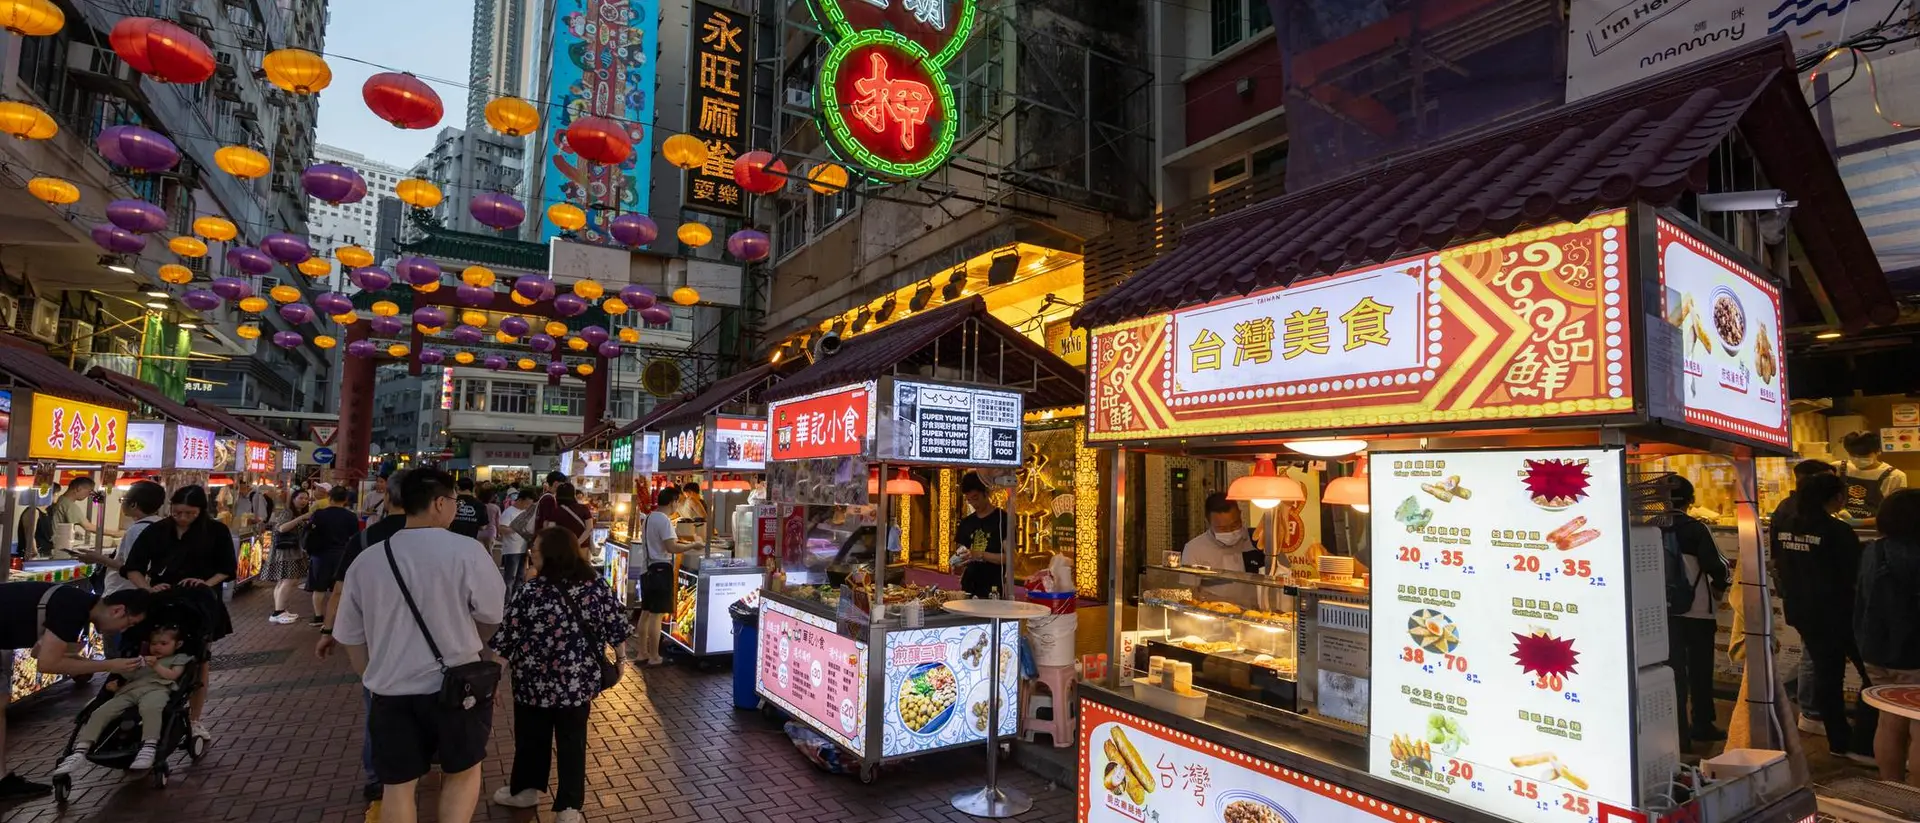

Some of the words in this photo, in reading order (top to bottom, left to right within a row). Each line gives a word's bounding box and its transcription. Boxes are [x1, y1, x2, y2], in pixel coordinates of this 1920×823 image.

[1601, 16, 1631, 40] I'm
[699, 11, 742, 181] 永旺麻雀
[851, 52, 934, 151] 押
[1256, 294, 1281, 305] TAIWAN
[1188, 295, 1394, 374] 台灣美食
[921, 412, 944, 422] SUPER
[944, 414, 969, 423] YUMMY
[48, 407, 118, 454] 美食大王
[796, 405, 860, 448] 華記小食
[921, 429, 944, 438] SUPER
[944, 431, 969, 440] YUMMY
[921, 445, 944, 454] SUPER
[944, 447, 969, 456] YUMMY
[993, 439, 1016, 449] STREET
[995, 447, 1013, 456] FOOD
[1491, 539, 1522, 548] Taiwanese
[895, 643, 947, 665] 煎釀三寶
